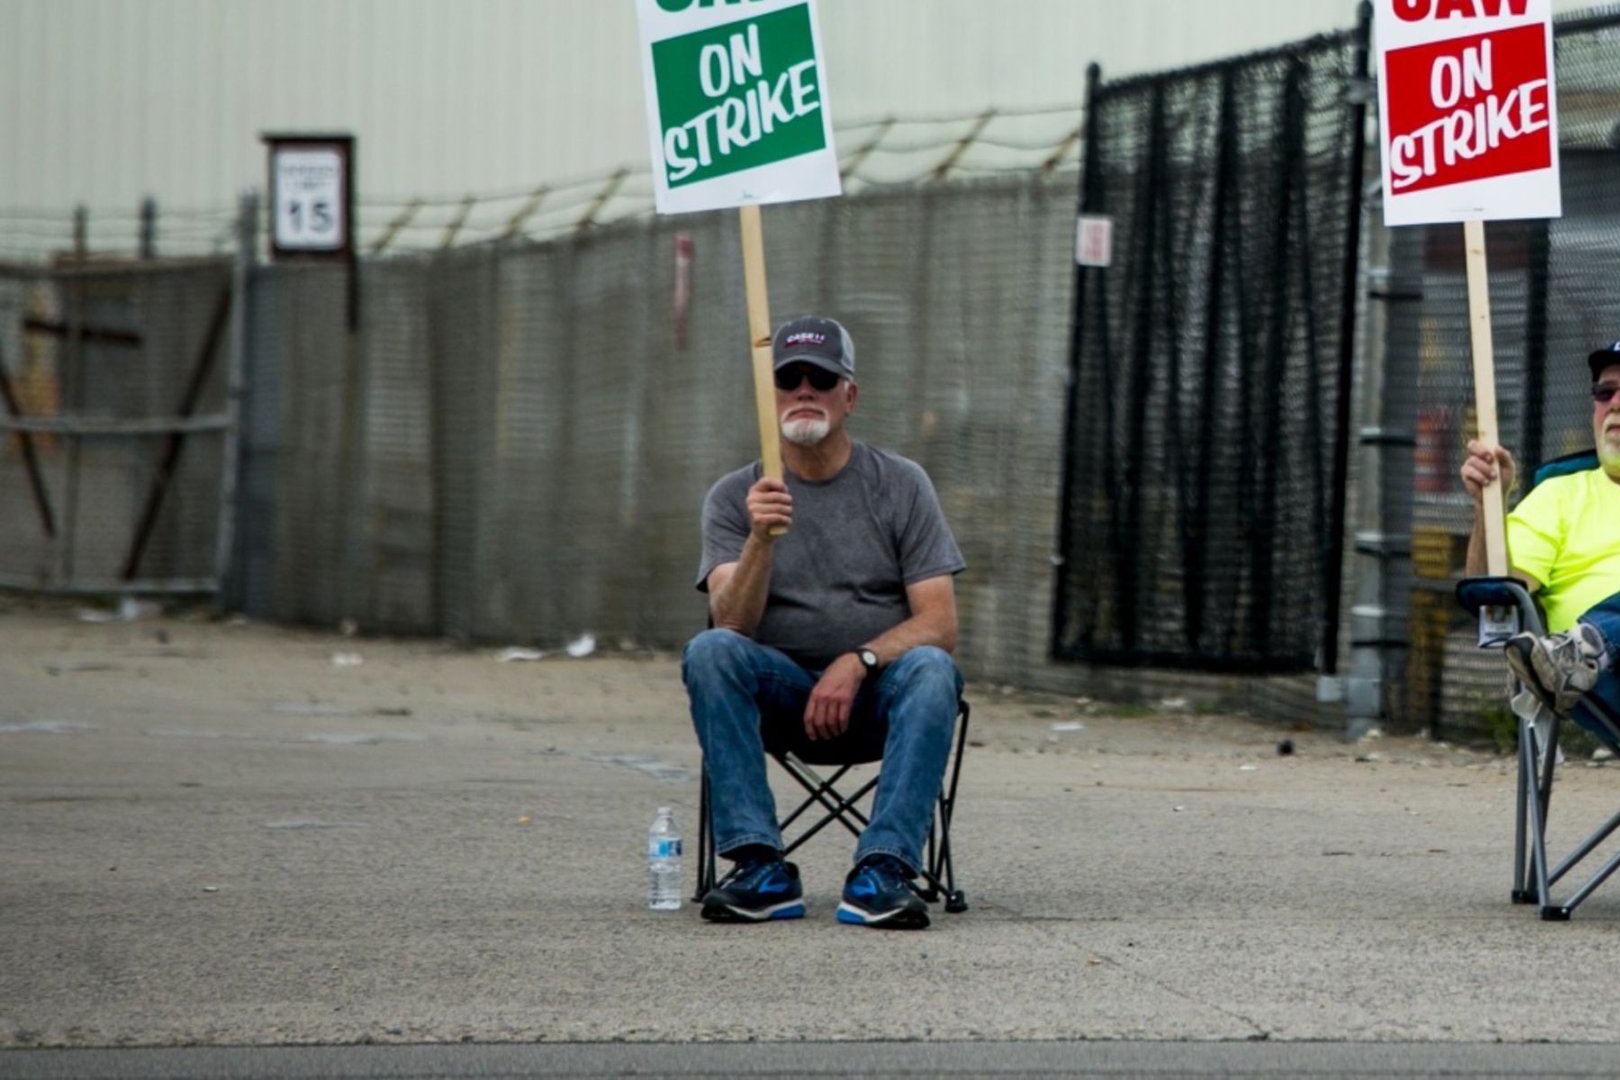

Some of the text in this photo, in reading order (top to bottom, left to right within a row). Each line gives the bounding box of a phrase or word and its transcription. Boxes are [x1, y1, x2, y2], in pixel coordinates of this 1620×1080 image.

[700, 23, 763, 97] ON
[1430, 38, 1493, 108] ON
[664, 59, 820, 182] STRIKE
[1390, 78, 1548, 189] STRIKE
[289, 200, 334, 234] 15
